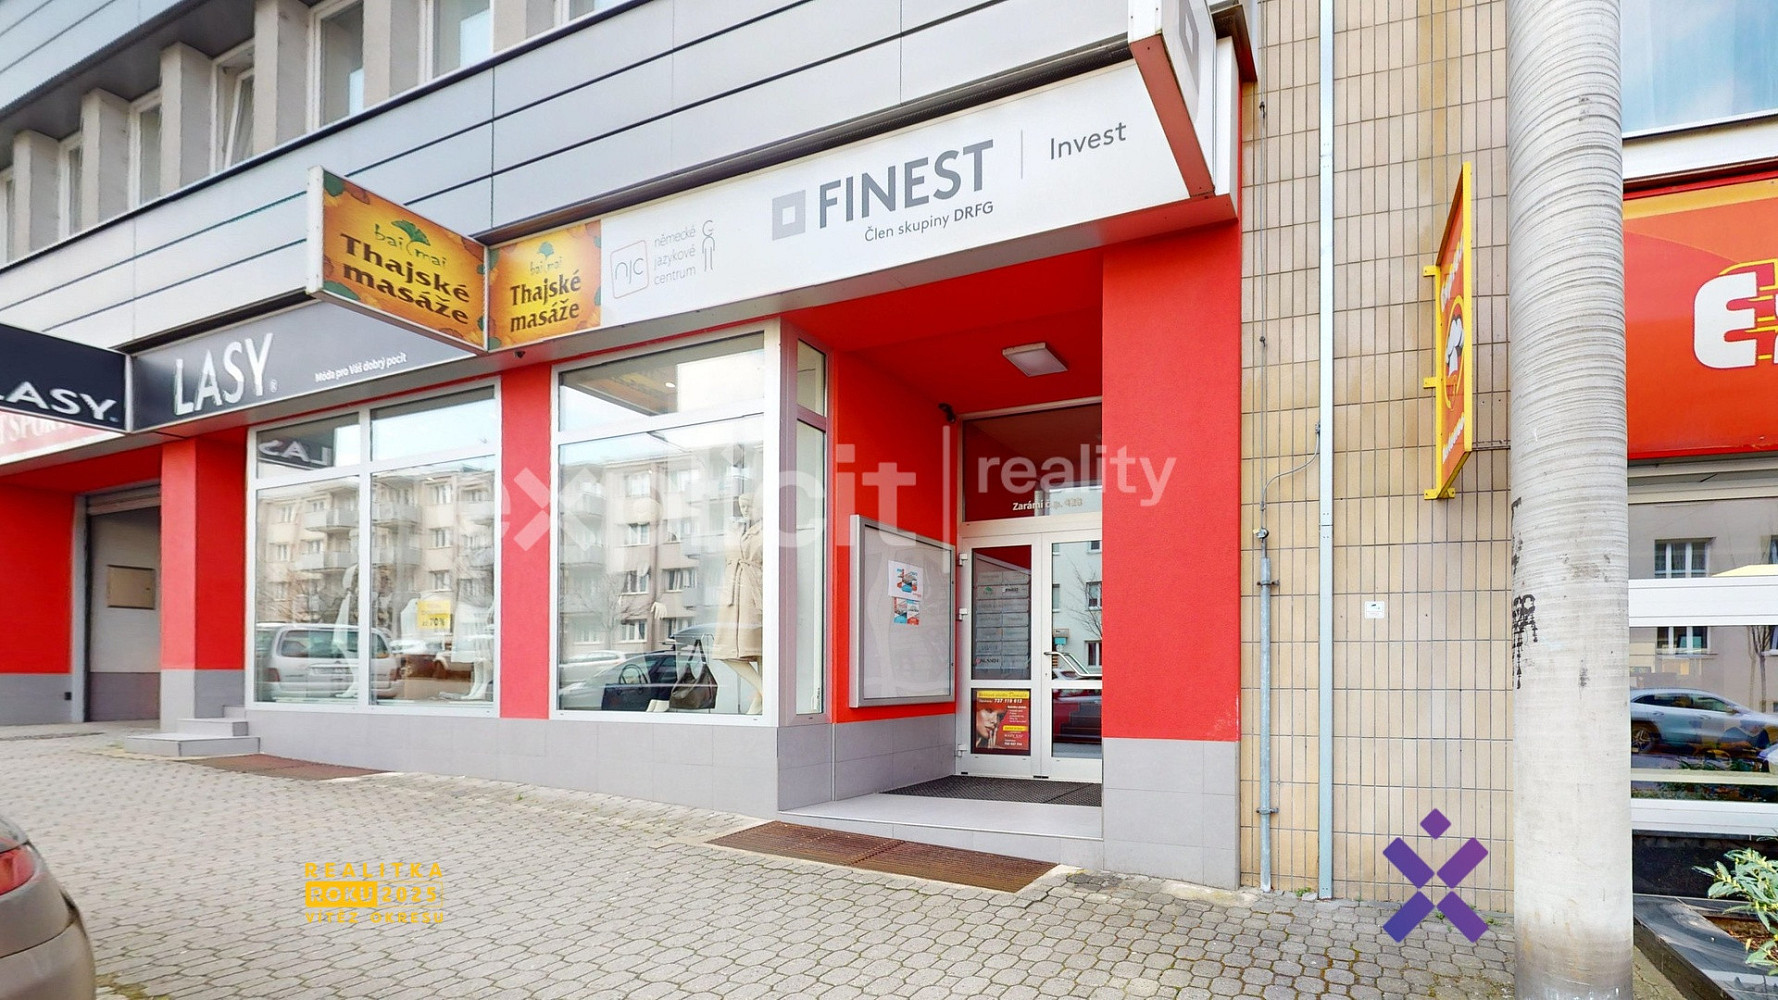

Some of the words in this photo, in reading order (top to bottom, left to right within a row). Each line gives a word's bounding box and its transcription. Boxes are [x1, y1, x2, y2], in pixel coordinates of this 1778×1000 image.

[1050, 122, 1127, 160] Invest
[820, 139, 994, 229] FINEST
[375, 224, 404, 248] bai
[655, 226, 696, 248] německé
[864, 226, 894, 242] Člen
[898, 215, 950, 236] skupiny
[954, 201, 994, 222] DRFG
[340, 233, 470, 303] Thajské
[654, 244, 696, 270] jazykové
[654, 266, 696, 285] centrum
[343, 263, 469, 325] masáže
[510, 269, 582, 307] Thajské
[510, 299, 580, 333] masáže
[335, 367, 349, 380] pro
[0, 381, 116, 421] ASY
